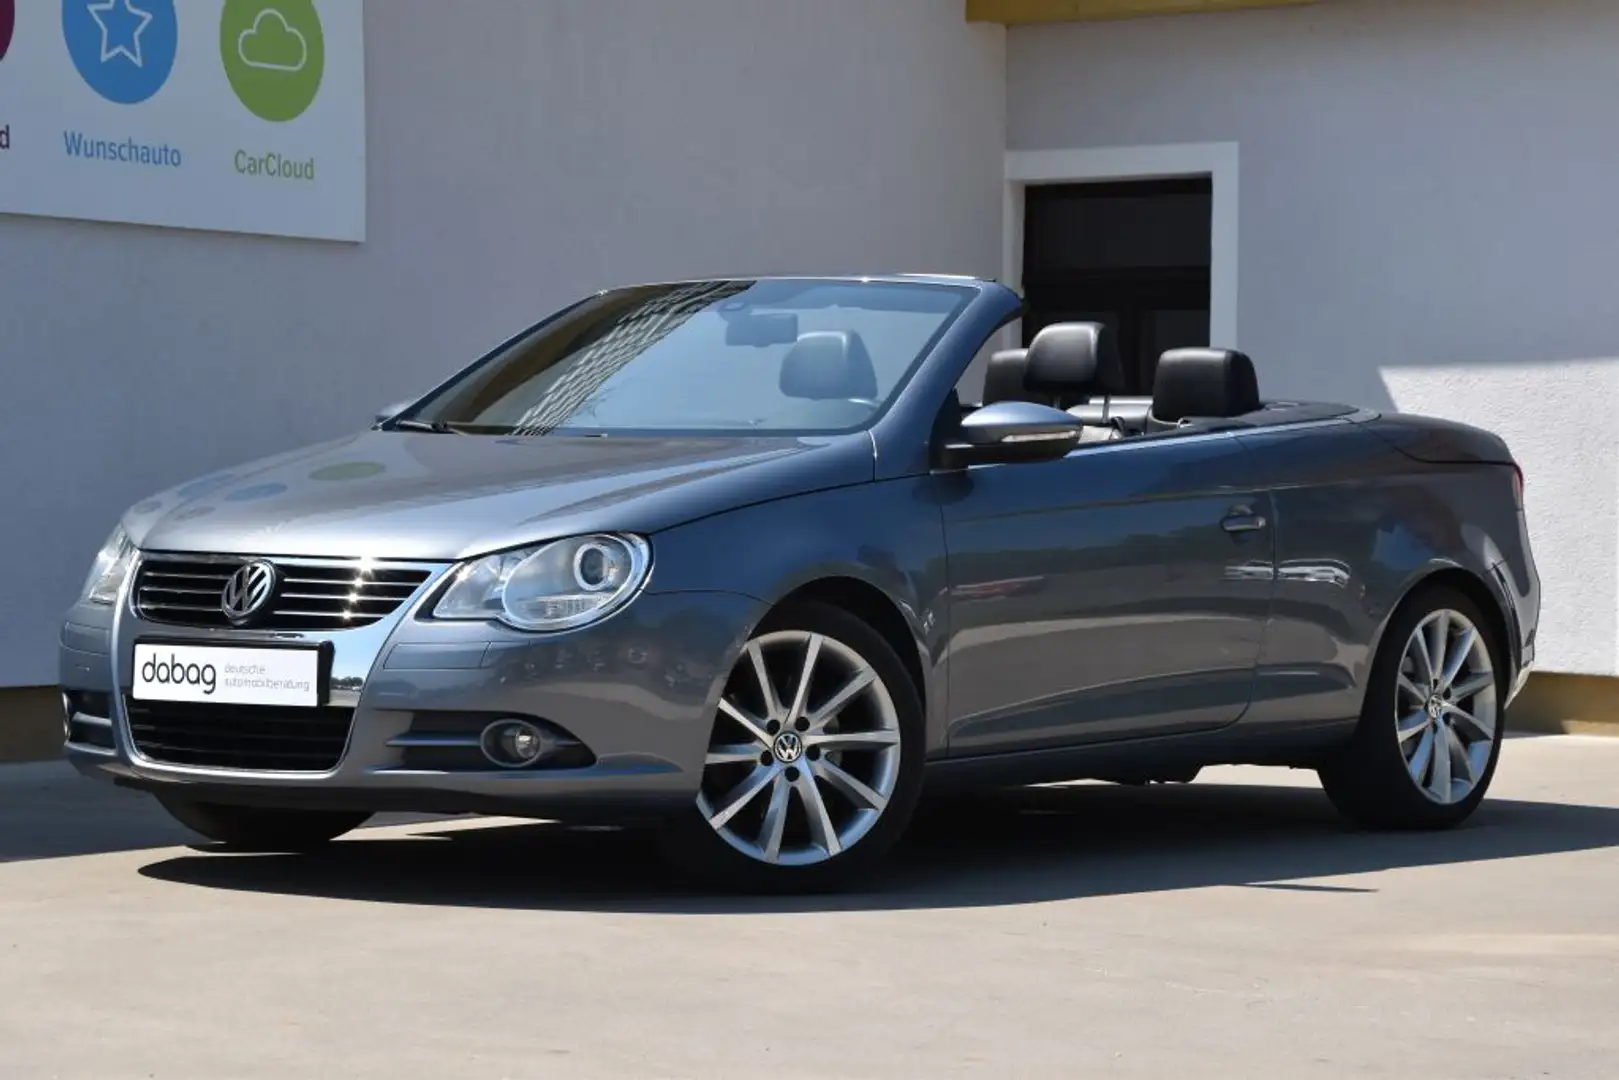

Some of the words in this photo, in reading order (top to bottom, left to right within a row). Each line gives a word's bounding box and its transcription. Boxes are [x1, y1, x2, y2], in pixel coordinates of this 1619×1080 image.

[63, 130, 182, 167] Wunschauto
[234, 150, 315, 180] CarCloud
[142, 653, 216, 695] dabag
